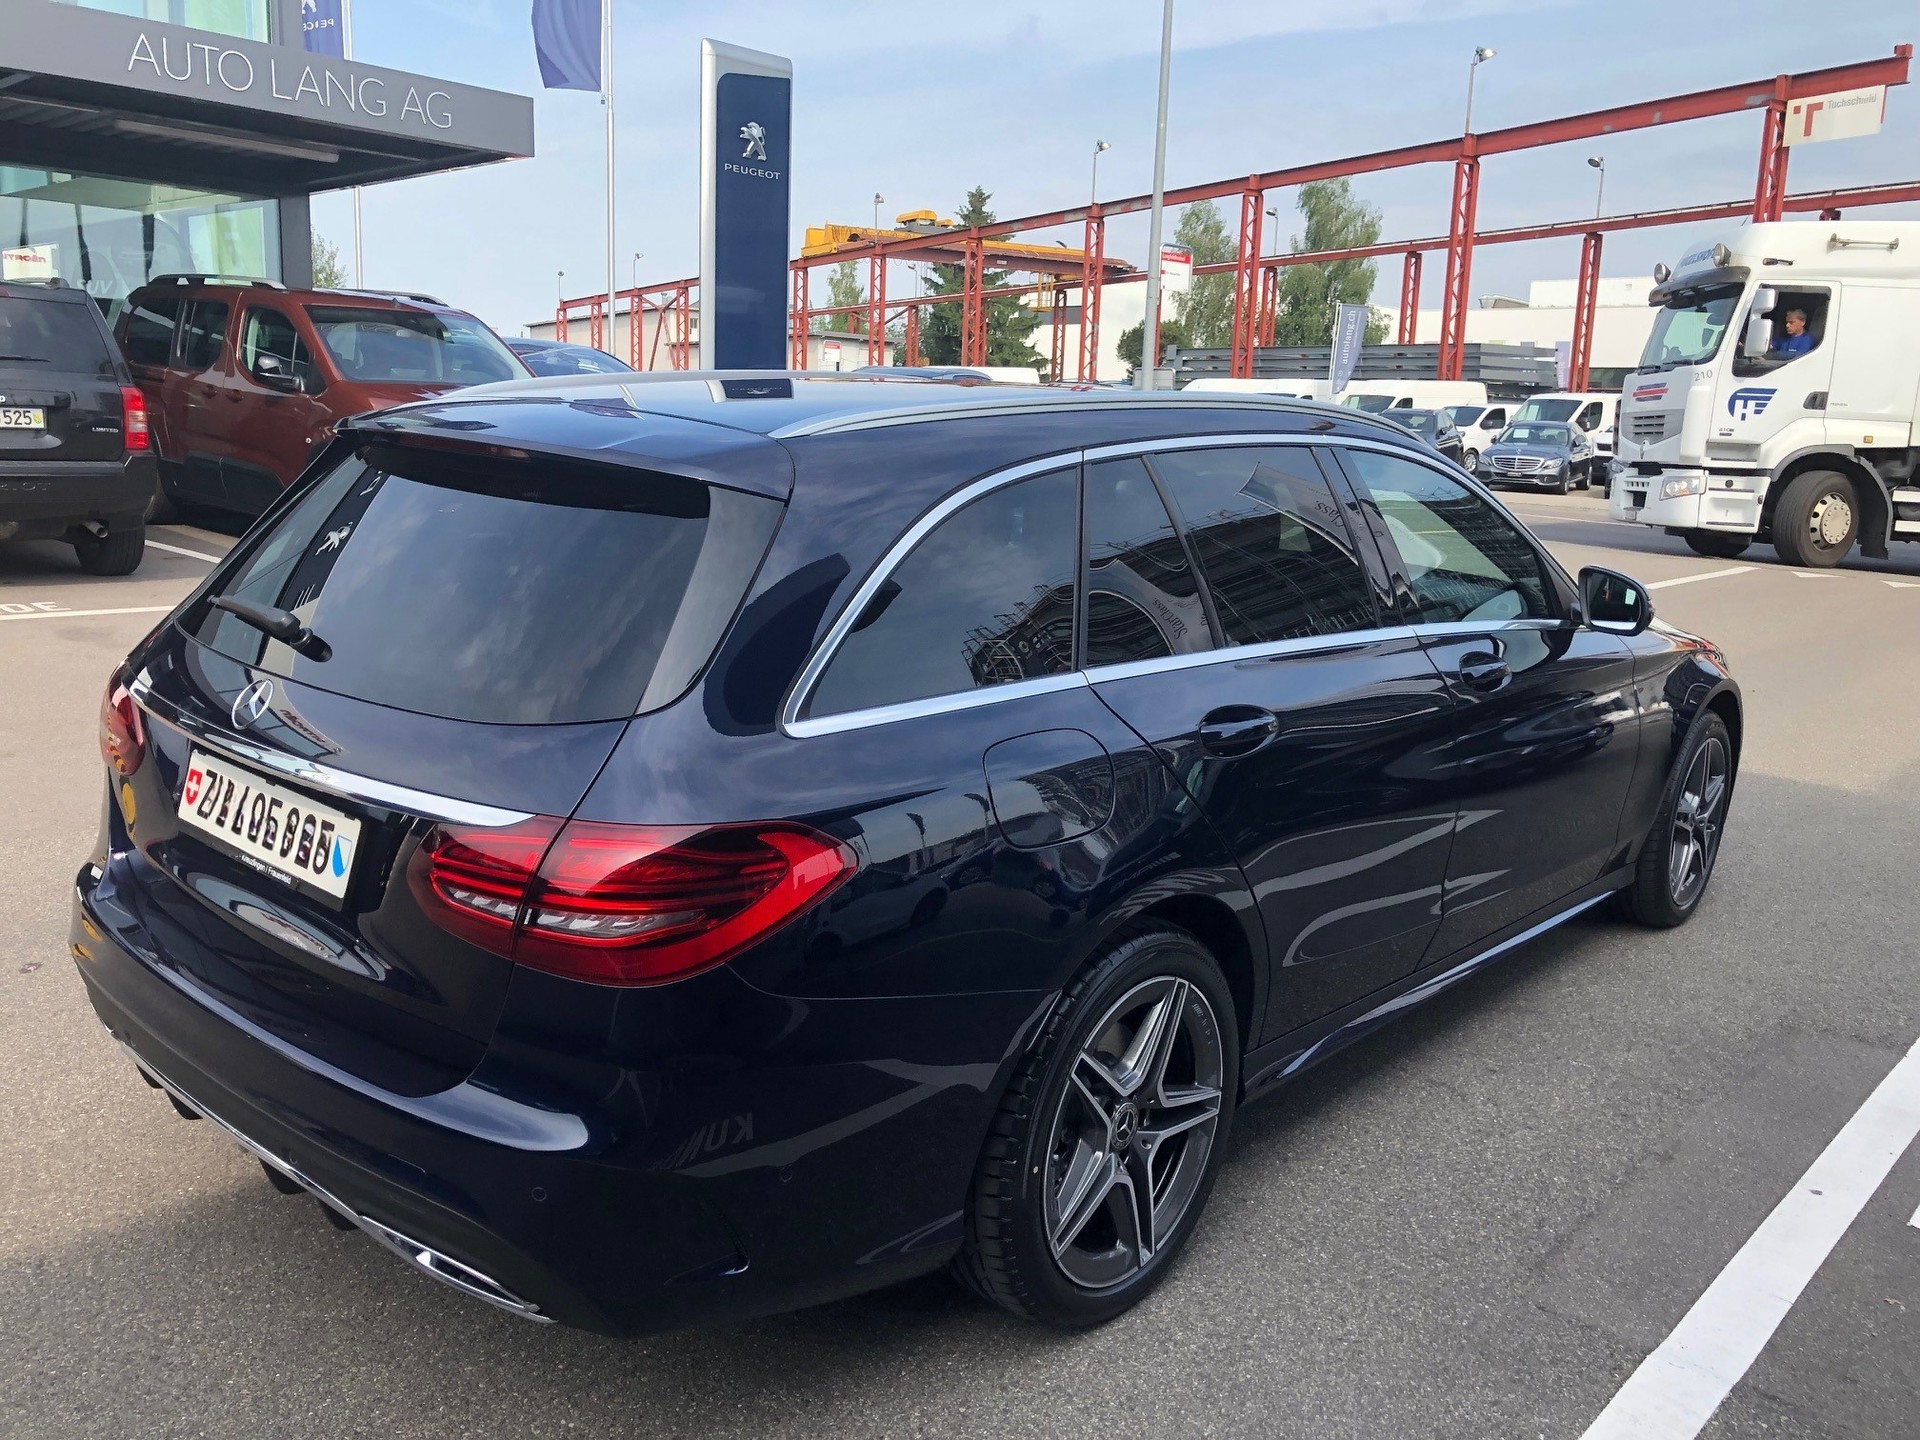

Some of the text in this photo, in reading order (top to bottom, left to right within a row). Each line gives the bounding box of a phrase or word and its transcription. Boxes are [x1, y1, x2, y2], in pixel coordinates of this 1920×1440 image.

[127, 33, 453, 129] AUTO LANG AG
[1827, 93, 1878, 111] Tuchschmid
[724, 162, 781, 180] PEUGEOT
[1342, 310, 1357, 365] autolang.ch
[1694, 369, 1713, 382] 210
